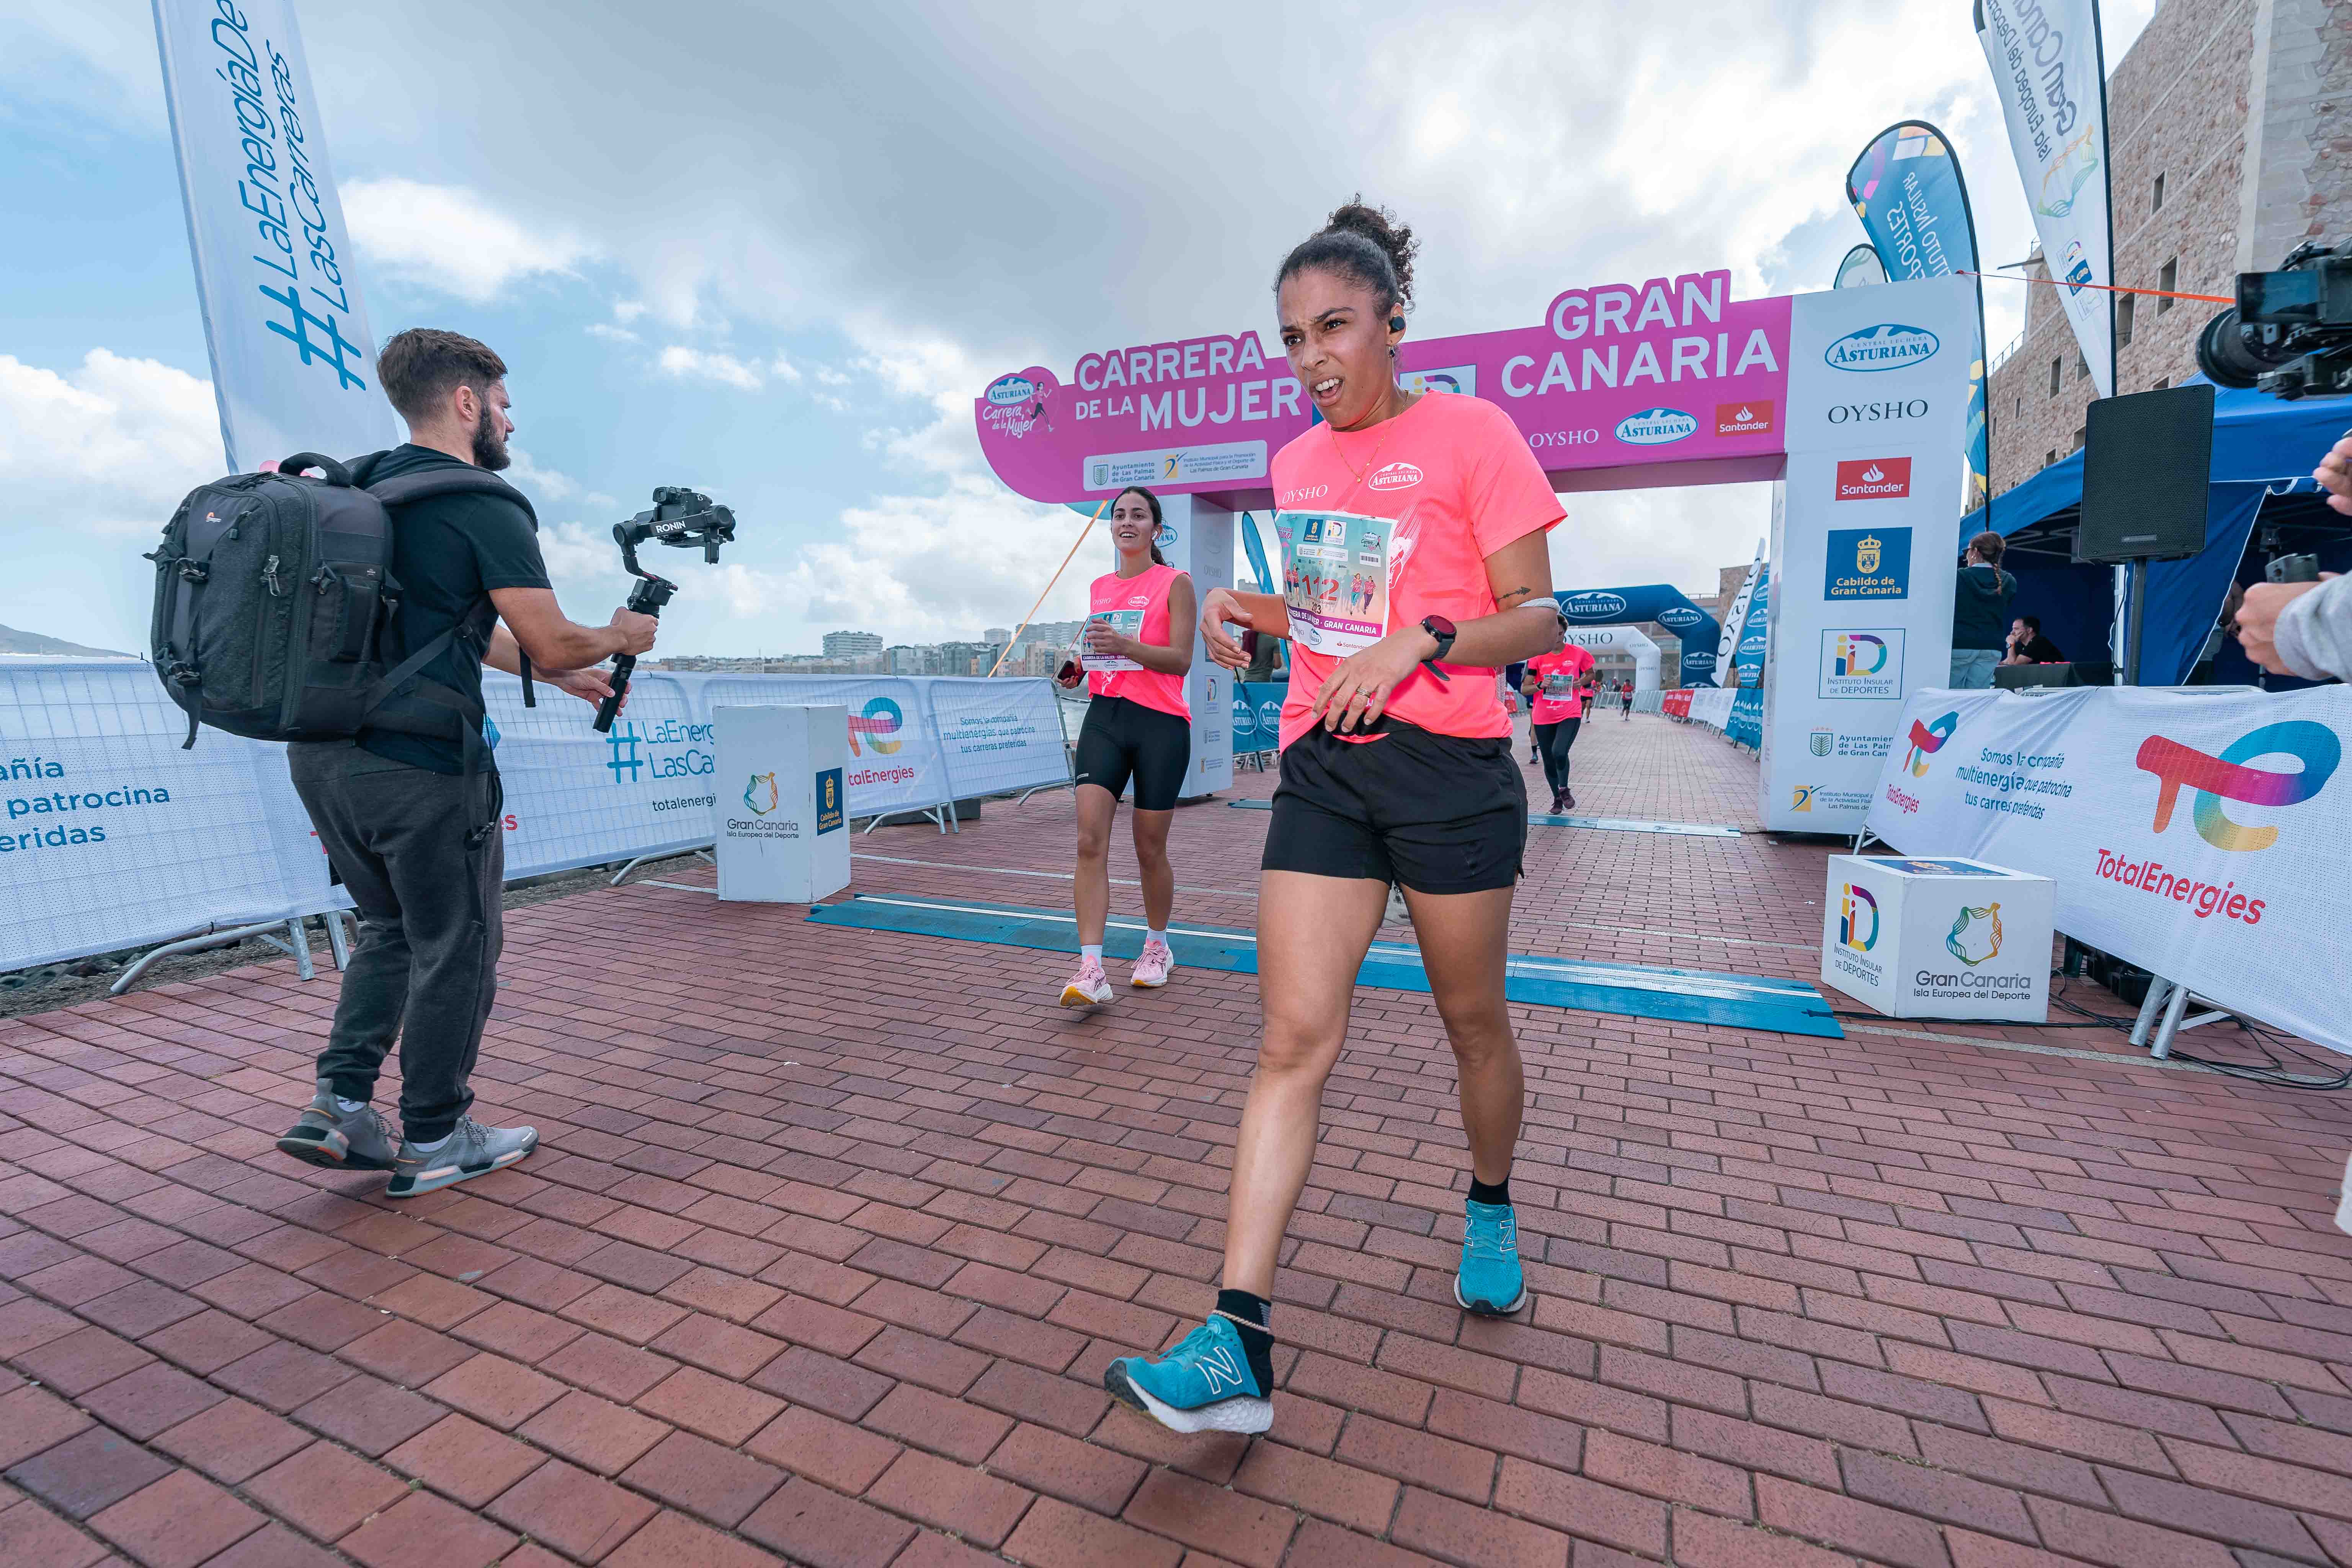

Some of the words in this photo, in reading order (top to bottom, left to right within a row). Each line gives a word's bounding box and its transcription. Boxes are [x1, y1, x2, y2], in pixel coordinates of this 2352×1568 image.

[265, 39, 350, 314] LasCarreras
[1553, 277, 1722, 340] GRAN
[1851, 340, 1886, 348] CENTRAL
[1833, 342, 1930, 364] ASTURIANA
[1079, 336, 1265, 392] CARRERA
[1501, 328, 1779, 398] CANARIA
[991, 389, 1031, 400] ASTURIANA
[1076, 399, 1101, 420] DE
[1107, 395, 1135, 416] LA
[1140, 377, 1302, 432] MUJER
[1827, 399, 1929, 424] OYSHO
[1621, 422, 1692, 438] ASTURIANA
[1719, 421, 1769, 433] Santander
[1528, 428, 1599, 448] OYSHO
[1112, 461, 1155, 470] Ayuntamiento
[1371, 474, 1418, 487] ASTURIANA
[1282, 484, 1328, 504] OYSHO
[1841, 482, 1904, 495] Santander
[655, 520, 686, 534] RONIN
[1836, 577, 1878, 587] Cabildo
[1880, 576, 1895, 586] de
[1830, 586, 1857, 596] Gran
[1859, 585, 1902, 595] Canaria
[1565, 602, 1620, 612] ASTURIANA
[1324, 620, 1343, 630] GRAN
[1345, 623, 1377, 635] CANARIA
[1841, 686, 1889, 694] DEPORTES
[960, 717, 983, 726] Somos
[998, 729, 1009, 737] que
[1010, 725, 1035, 735] patrocina
[960, 745, 972, 753] tus
[973, 742, 998, 752] carreras
[998, 739, 1027, 750] preferidas
[1981, 747, 2012, 766] Somos
[2024, 778, 2038, 793] que
[2035, 779, 2072, 798] patrocina
[7, 785, 170, 820] patrocina
[1886, 783, 1920, 815] TotalEnergies
[1965, 791, 1978, 806] tus
[2011, 800, 2045, 820] preferidas
[727, 818, 754, 830] Gran
[755, 819, 799, 831] Canaria
[818, 822, 828, 830] Gran
[828, 817, 842, 827] Canaria
[820, 812, 834, 822] Cabildo
[2095, 848, 2266, 924] TotalEnergies
[1843, 960, 1879, 987] DEPORTES
[1916, 970, 1958, 987] Gran
[1960, 971, 2031, 989] Canaria
[1914, 988, 1929, 997] Isla
[1932, 989, 1971, 1000] Europea
[1973, 990, 1989, 999] del
[1991, 990, 2031, 1001] Deporte
